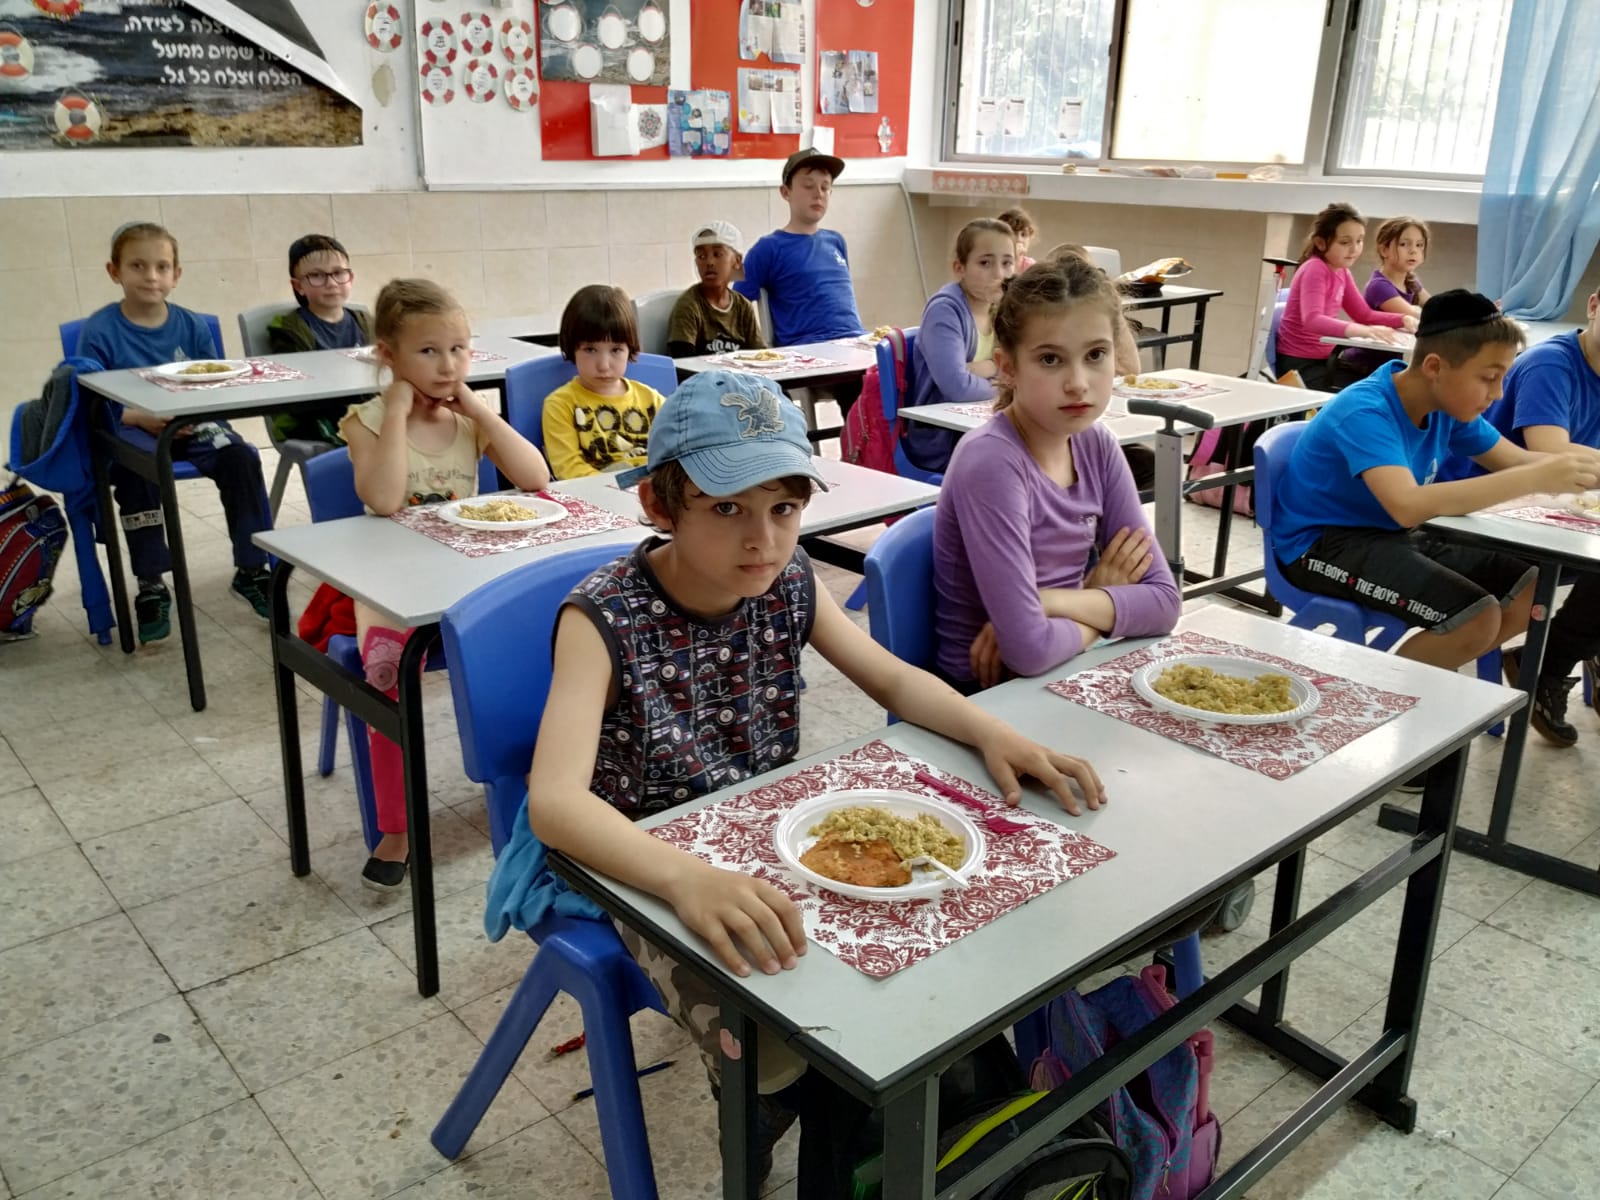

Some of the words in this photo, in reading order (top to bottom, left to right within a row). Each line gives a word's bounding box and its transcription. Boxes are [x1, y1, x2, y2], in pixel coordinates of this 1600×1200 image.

[190, 16, 237, 34] צלה
[152, 38, 204, 59] ממעל
[208, 44, 254, 60] שמים
[188, 65, 210, 84] כל
[214, 67, 254, 86] וצלח
[1308, 558, 1326, 574] THE
[1325, 564, 1350, 584] BOYS
[1355, 578, 1374, 596] THE
[1372, 585, 1400, 605] BOYS
